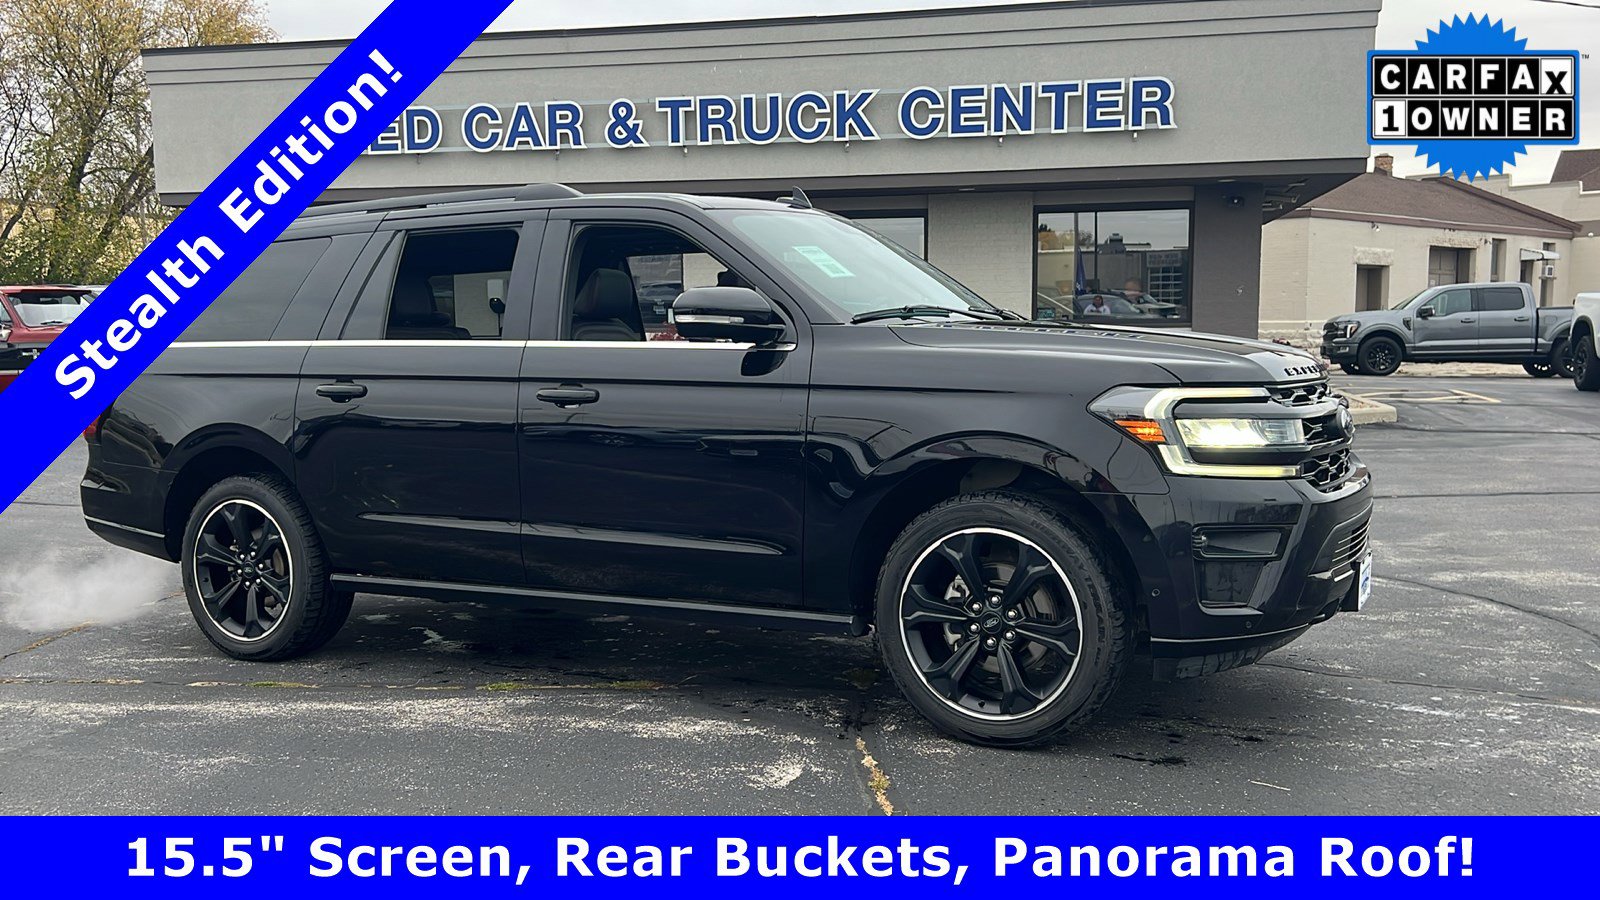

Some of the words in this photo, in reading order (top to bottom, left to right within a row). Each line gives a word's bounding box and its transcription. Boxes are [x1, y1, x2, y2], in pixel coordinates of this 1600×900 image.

[367, 105, 443, 155] ED
[461, 100, 588, 152] CAR
[604, 98, 649, 149] &
[655, 88, 881, 147] TRUCK
[898, 75, 1178, 139] CENTER
